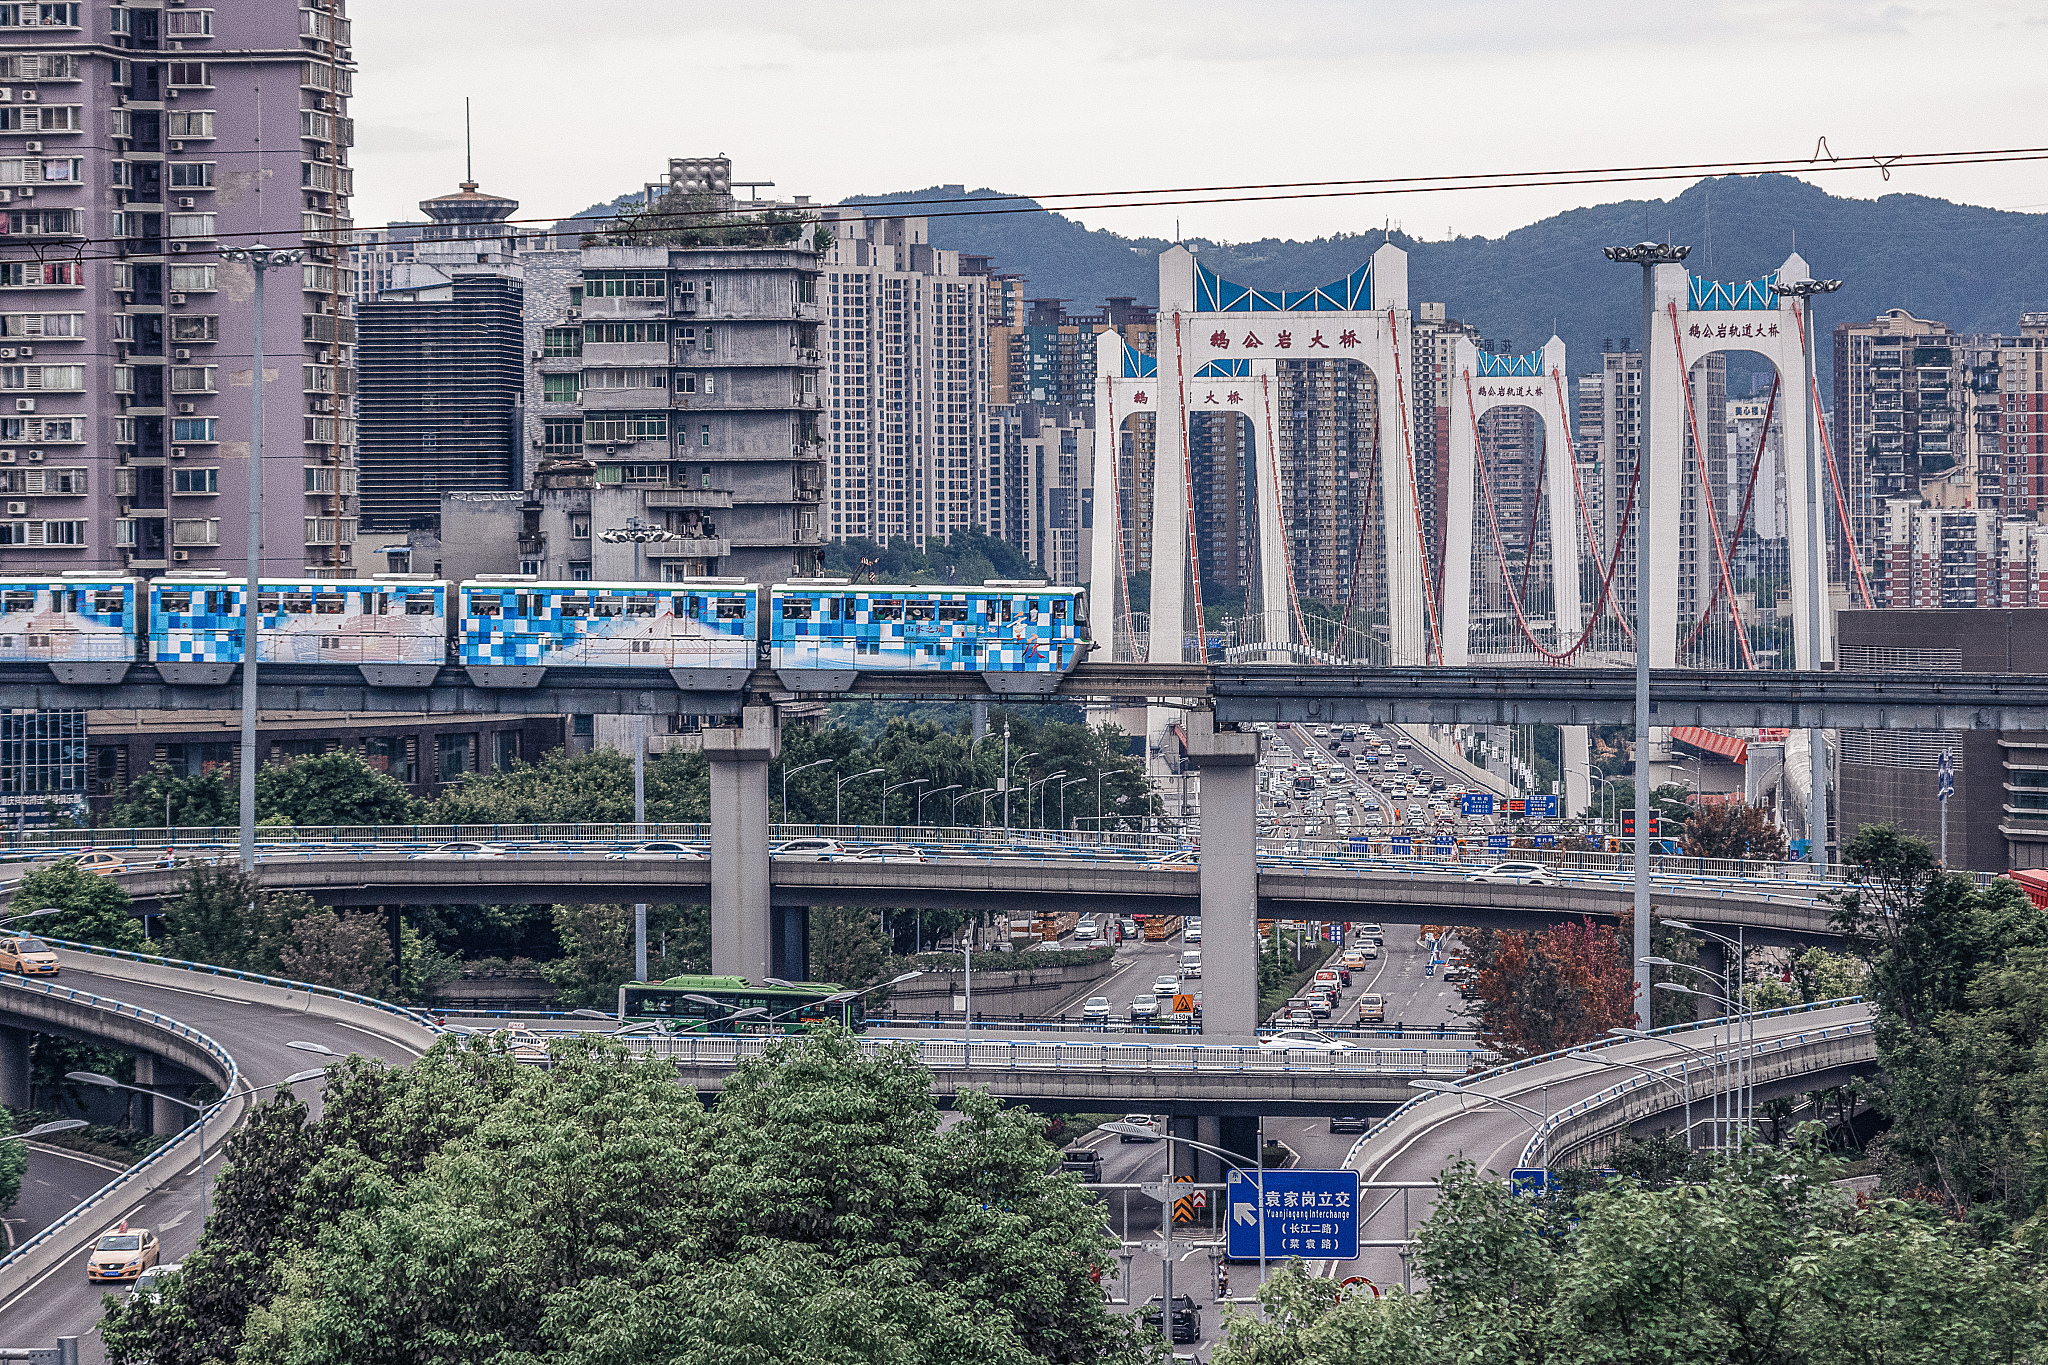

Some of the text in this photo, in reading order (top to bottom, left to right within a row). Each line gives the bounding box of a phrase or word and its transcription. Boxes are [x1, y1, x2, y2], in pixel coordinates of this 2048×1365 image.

[1689, 323, 1780, 339] 鹅公岩轨道大桥
[1210, 329, 1361, 349] 鹅公岩大桥
[1134, 390, 1244, 405] 鹅大桥
[1478, 385, 1544, 397] 鹅公岩轨道大桥
[905, 625, 946, 634] 山水之城
[1265, 1191, 1351, 1208] 袁家岗立交
[1266, 1208, 1350, 1221] Yuanjiagang Interchange
